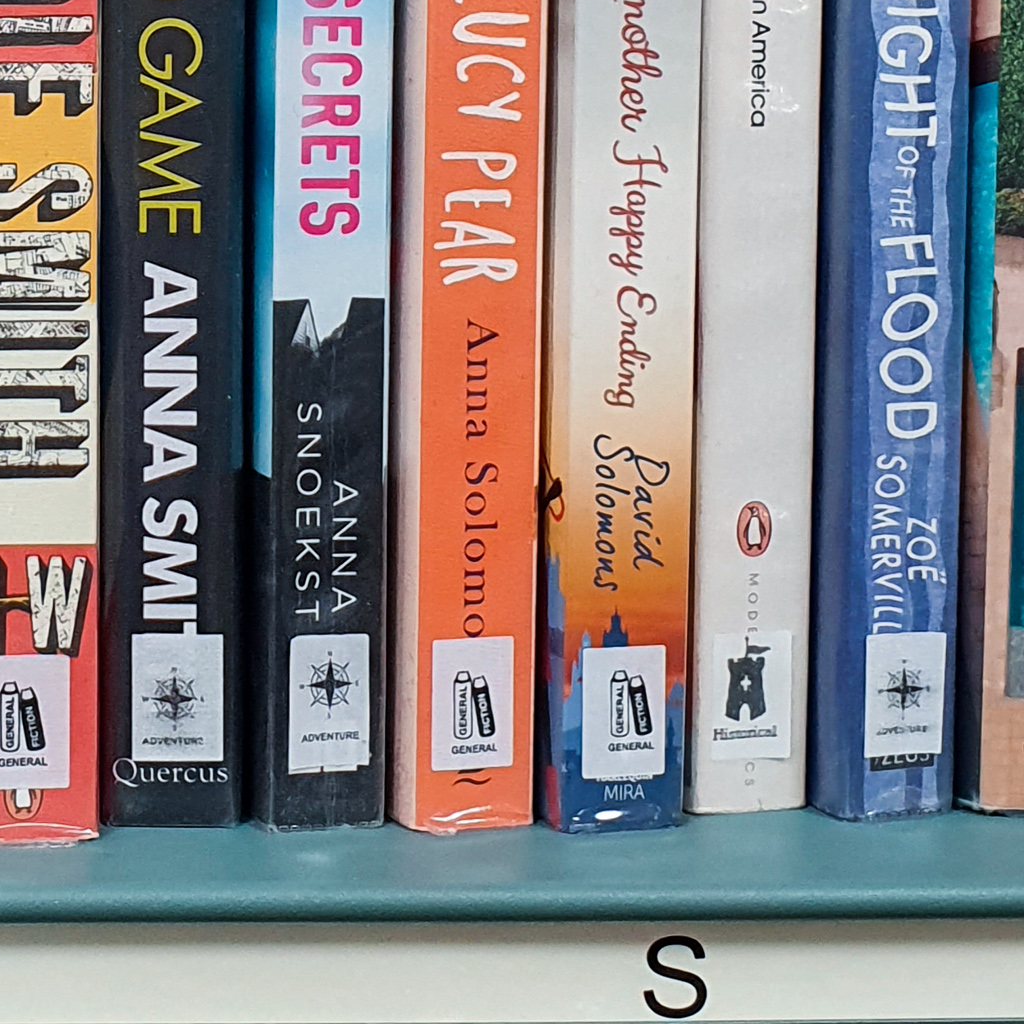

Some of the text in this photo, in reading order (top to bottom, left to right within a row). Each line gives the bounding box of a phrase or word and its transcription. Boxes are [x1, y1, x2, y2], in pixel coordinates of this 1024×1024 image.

[749, 22, 773, 128] America
[137, 17, 204, 235] GAME
[895, 146, 920, 180] OF
[433, 151, 519, 286] PEAR
[608, 139, 669, 277] Happy
[889, 184, 914, 228] THE
[603, 285, 658, 409] Ending
[878, 234, 939, 440] FLOOD
[141, 261, 199, 634] ANNA SMI
[463, 317, 501, 638] Anna Solomo
[293, 402, 323, 622] SNOEKST
[331, 479, 360, 614] ANNA
[592, 433, 635, 592] Solomons
[631, 451, 671, 572] David
[869, 454, 908, 634] SOMERVILL
[907, 517, 948, 585] ZOË
[747, 572, 761, 633] MODE
[5, 697, 15, 748] GENERAL
[26, 705, 41, 748] FICTION
[301, 731, 360, 744] ADVENTURE
[459, 686, 468, 736] GENERAL
[608, 741, 655, 752] GENERAL
[615, 684, 625, 734] GENERAL
[712, 725, 779, 741] Historical
[113, 757, 229, 788] Quercus
[451, 743, 498, 755] GENERAL
[603, 784, 646, 802] MIRA
[642, 933, 708, 1021] S
